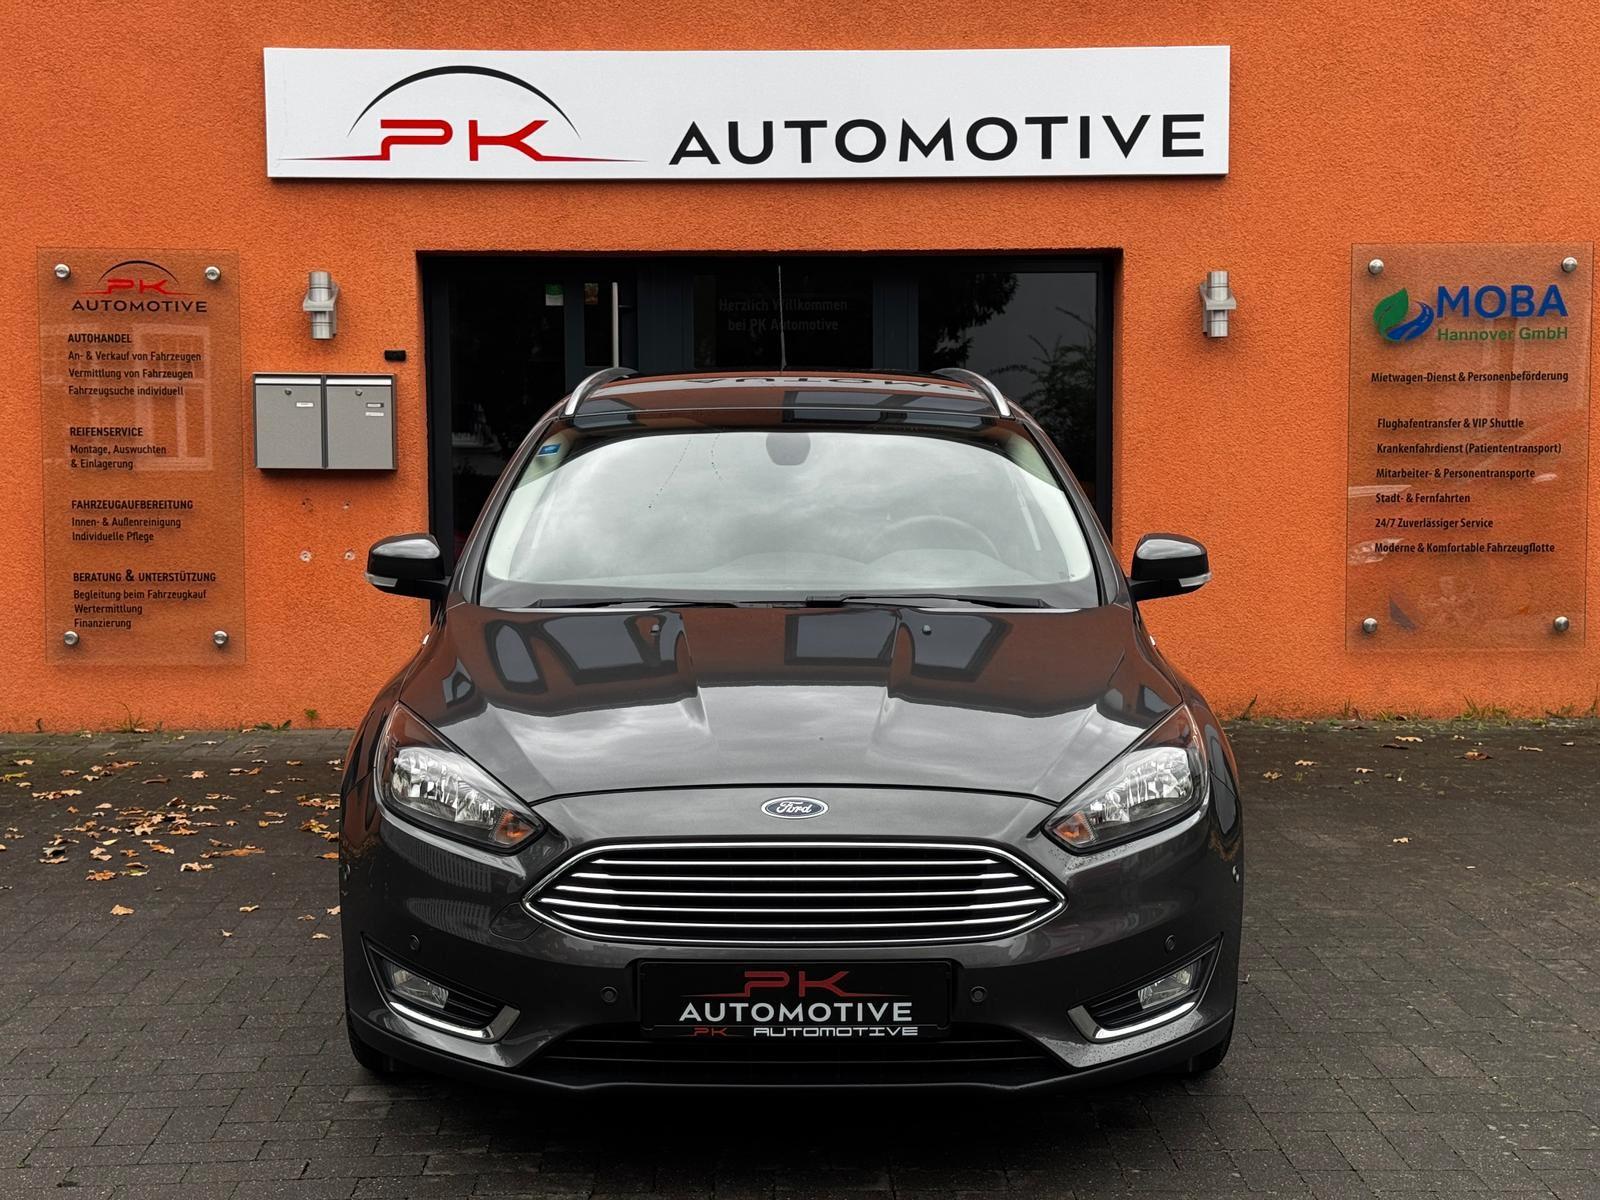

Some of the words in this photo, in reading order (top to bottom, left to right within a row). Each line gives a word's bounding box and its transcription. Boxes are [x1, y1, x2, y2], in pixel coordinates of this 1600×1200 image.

[380, 119, 549, 162] PK
[668, 113, 1205, 166] AUTOMOTIVE
[108, 279, 167, 294] PK
[72, 300, 207, 312] AUTOMOTIVE
[719, 298, 768, 312] Herzlich
[773, 298, 848, 311] Willkommen
[1436, 284, 1568, 319] MOBA
[728, 318, 746, 331] bei
[750, 319, 766, 331] PK
[771, 318, 838, 331] Automotive
[68, 334, 132, 343] AUTOHANDEL
[1438, 328, 1514, 341] Hannover
[1519, 327, 1567, 340] GmbH
[68, 352, 83, 361] An-
[86, 352, 92, 361] &
[95, 351, 129, 361] Verkauf
[151, 352, 201, 363] Fahrzeugen
[69, 368, 121, 380] Vermittlung
[143, 369, 193, 381] Fahrzeugen
[1371, 372, 1456, 384] Mietwagen-Dienst
[1459, 372, 1465, 382] &
[1468, 371, 1568, 383] Personenbeförderung
[69, 386, 134, 397] Fahrzeugsuche
[137, 386, 183, 396] individuell
[1378, 418, 1461, 430] Flughafentransfer
[1464, 419, 1470, 428] &
[1472, 419, 1487, 428] VIP
[1490, 418, 1524, 428] Shuttle
[70, 427, 143, 436] REIFENSERVICE
[70, 445, 110, 455] Montage,
[113, 445, 166, 454] Auswuchten
[1377, 443, 1463, 454] Krankenfahrdienst
[1465, 443, 1561, 455] (Patiententransport)
[71, 460, 77, 468] &
[80, 459, 133, 470] Einlagerung
[1376, 468, 1432, 478] Mitarbeiter-
[1434, 469, 1441, 478] &
[1444, 469, 1535, 480] Personentransporte
[1376, 493, 1404, 503] Stadt-
[1406, 493, 1413, 503] &
[1415, 493, 1470, 503] Fernfahrten
[72, 500, 193, 509] FAHRZEUGAUFBEREITUNG
[72, 518, 100, 527] Innen-
[103, 518, 108, 527] &
[112, 517, 181, 529] Außenreinigung
[1376, 518, 1395, 528] 24/7
[1398, 518, 1458, 530] Zuverlässiger
[1461, 518, 1493, 528] Service
[72, 532, 123, 541] Individuelle
[127, 532, 154, 543] Pflege
[1375, 543, 1415, 553] Moderne
[1417, 543, 1425, 553] &
[1427, 543, 1484, 553] Komfortable
[1487, 543, 1555, 554] Fahrzeugflotte
[73, 572, 121, 582] BERATUNG
[126, 569, 134, 582] &
[139, 570, 216, 582] UNTERSTÜTZUNG
[74, 590, 121, 601] Begleitung
[123, 590, 144, 599] beim
[148, 590, 206, 601] Fahrzeugkauf
[74, 604, 142, 615] Wertermittlung
[74, 618, 131, 629] Finanzierung
[776, 801, 812, 813] Ford
[744, 971, 849, 997] PK
[679, 1002, 912, 1022] AUTOMOTIVE
[693, 1027, 728, 1037] PK
[754, 1027, 918, 1036] AUTOMOTIVE
